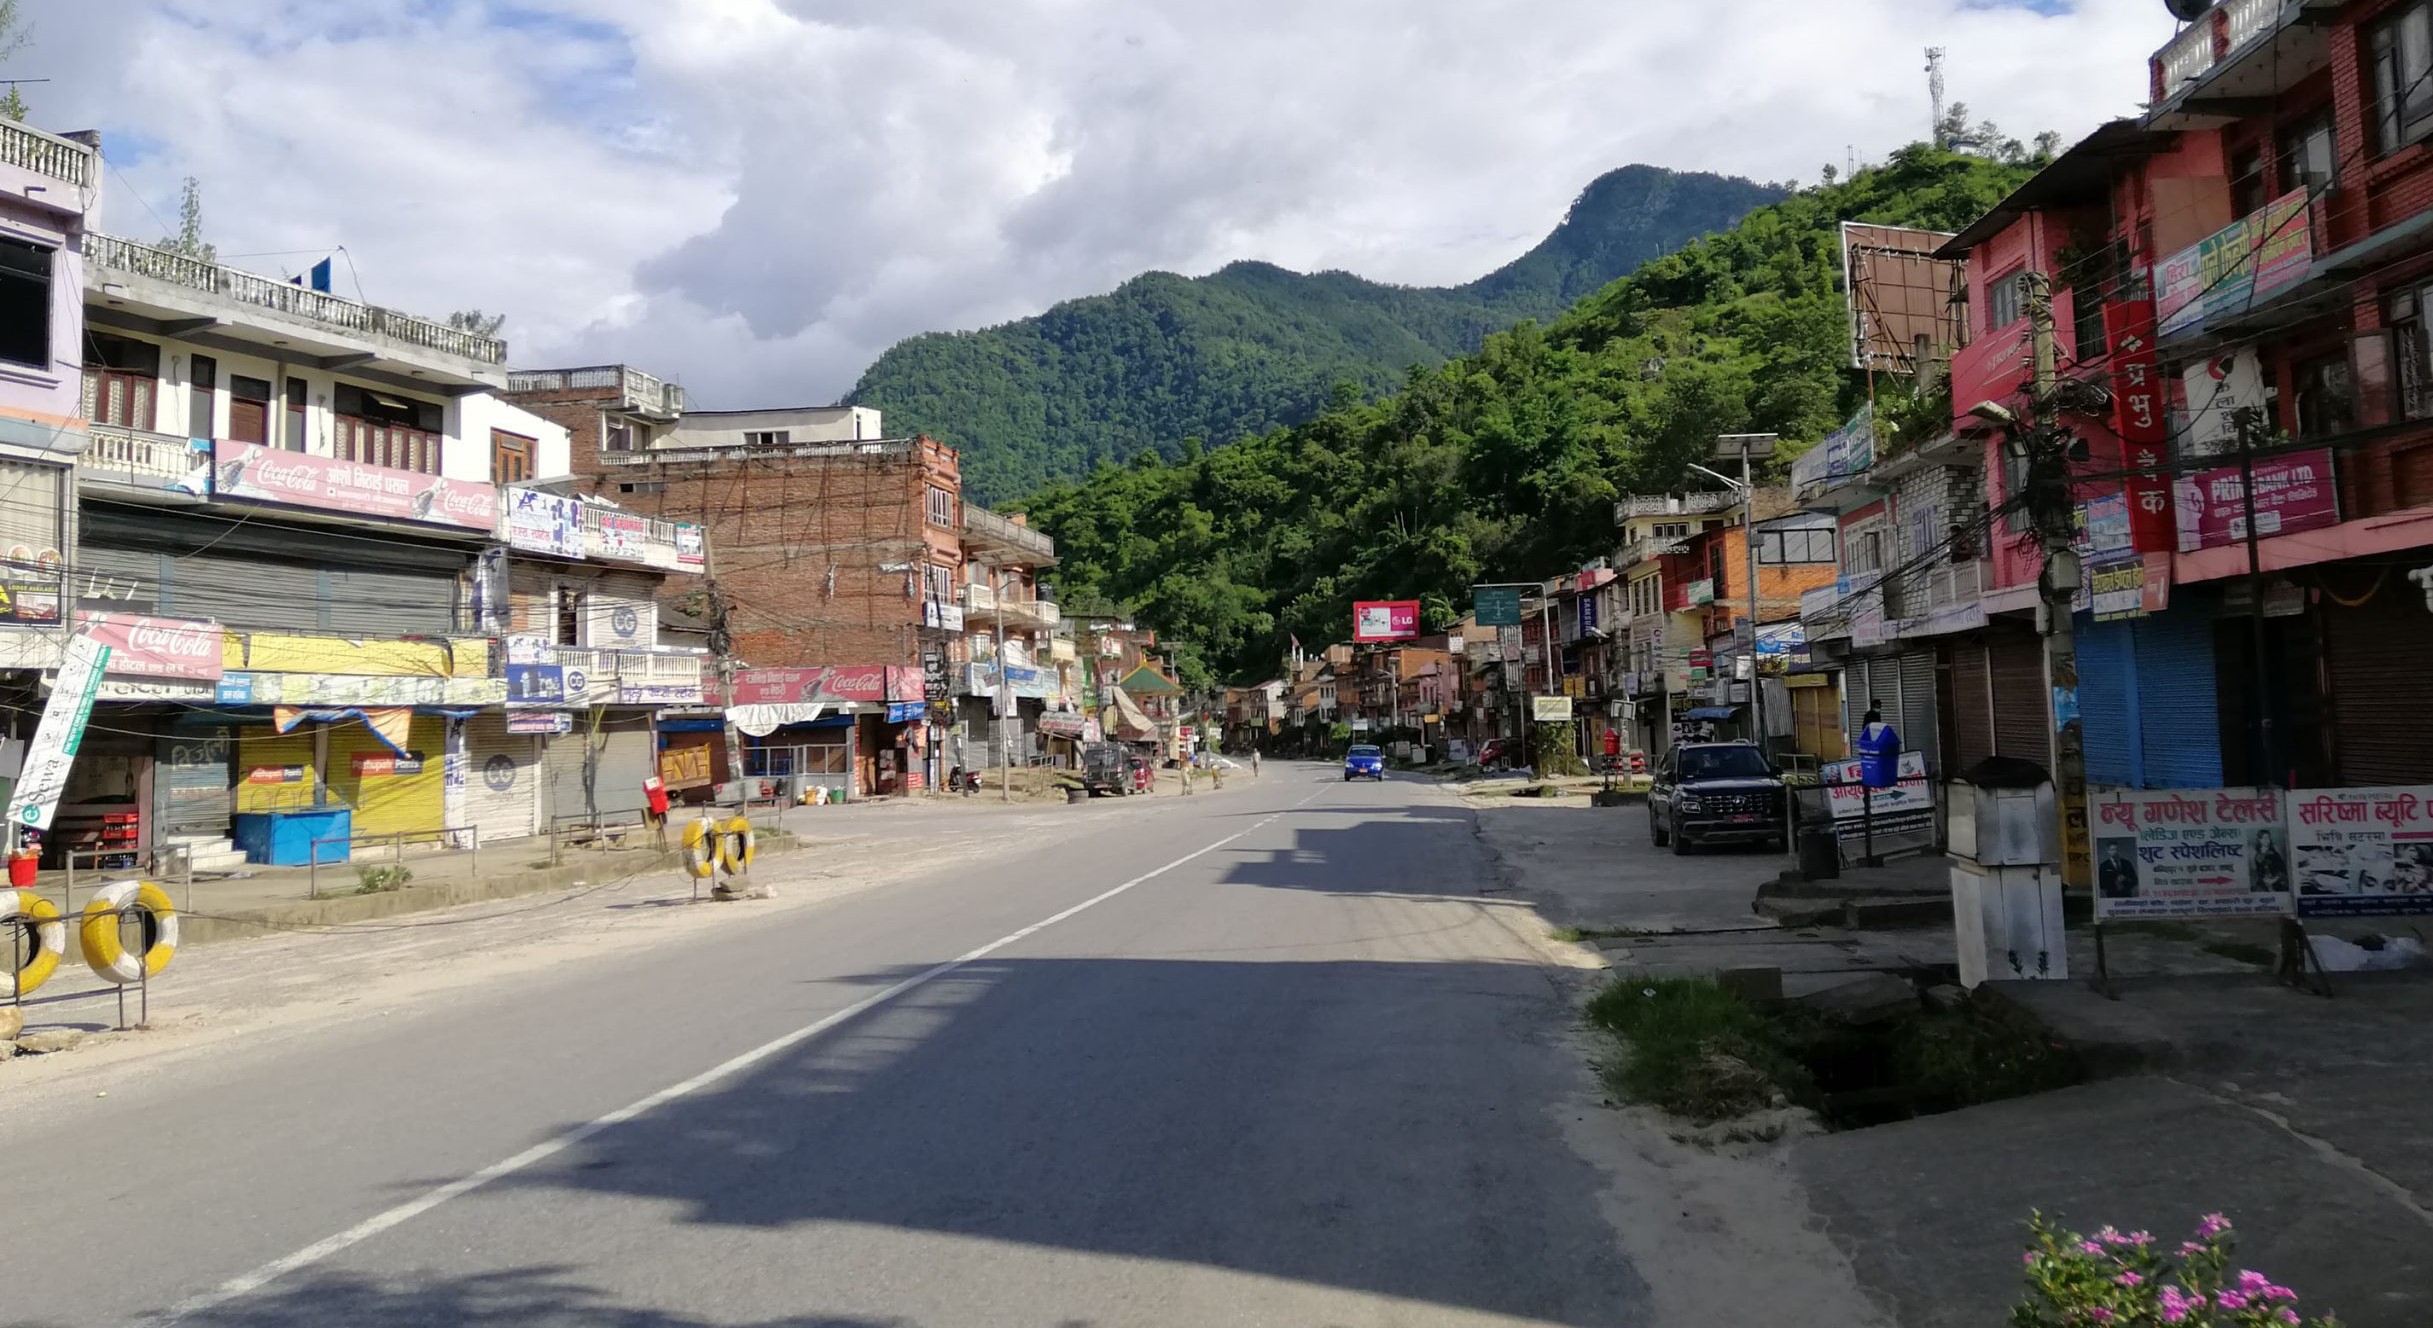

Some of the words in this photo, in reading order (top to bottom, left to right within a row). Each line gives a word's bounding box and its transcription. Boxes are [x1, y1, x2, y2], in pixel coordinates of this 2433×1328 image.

[2257, 470, 2290, 494] BANK
[2100, 801, 2140, 832] न्यू
[2144, 794, 2208, 824] गणेश
